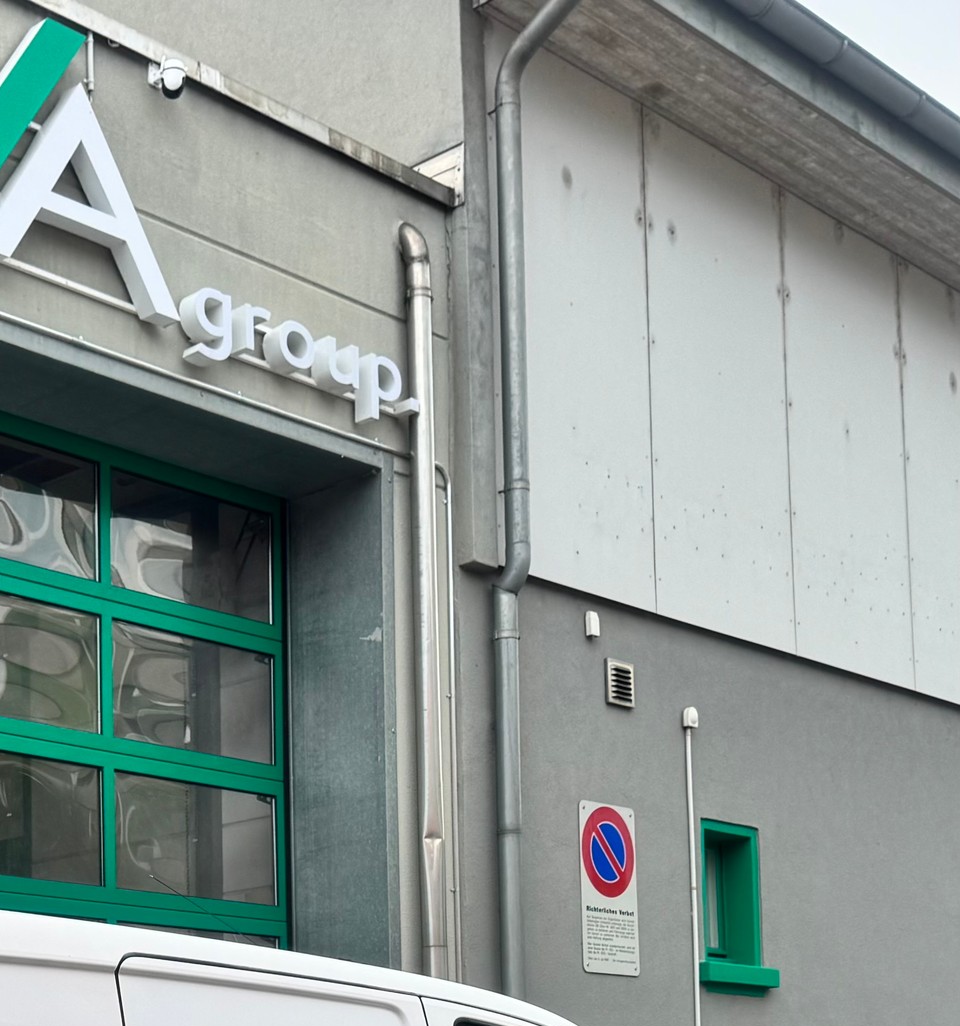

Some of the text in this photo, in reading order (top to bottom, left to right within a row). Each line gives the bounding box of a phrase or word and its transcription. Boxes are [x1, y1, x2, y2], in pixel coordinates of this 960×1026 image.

[180, 286, 405, 424] group
[586, 905, 635, 917] Richterliches Verbot
